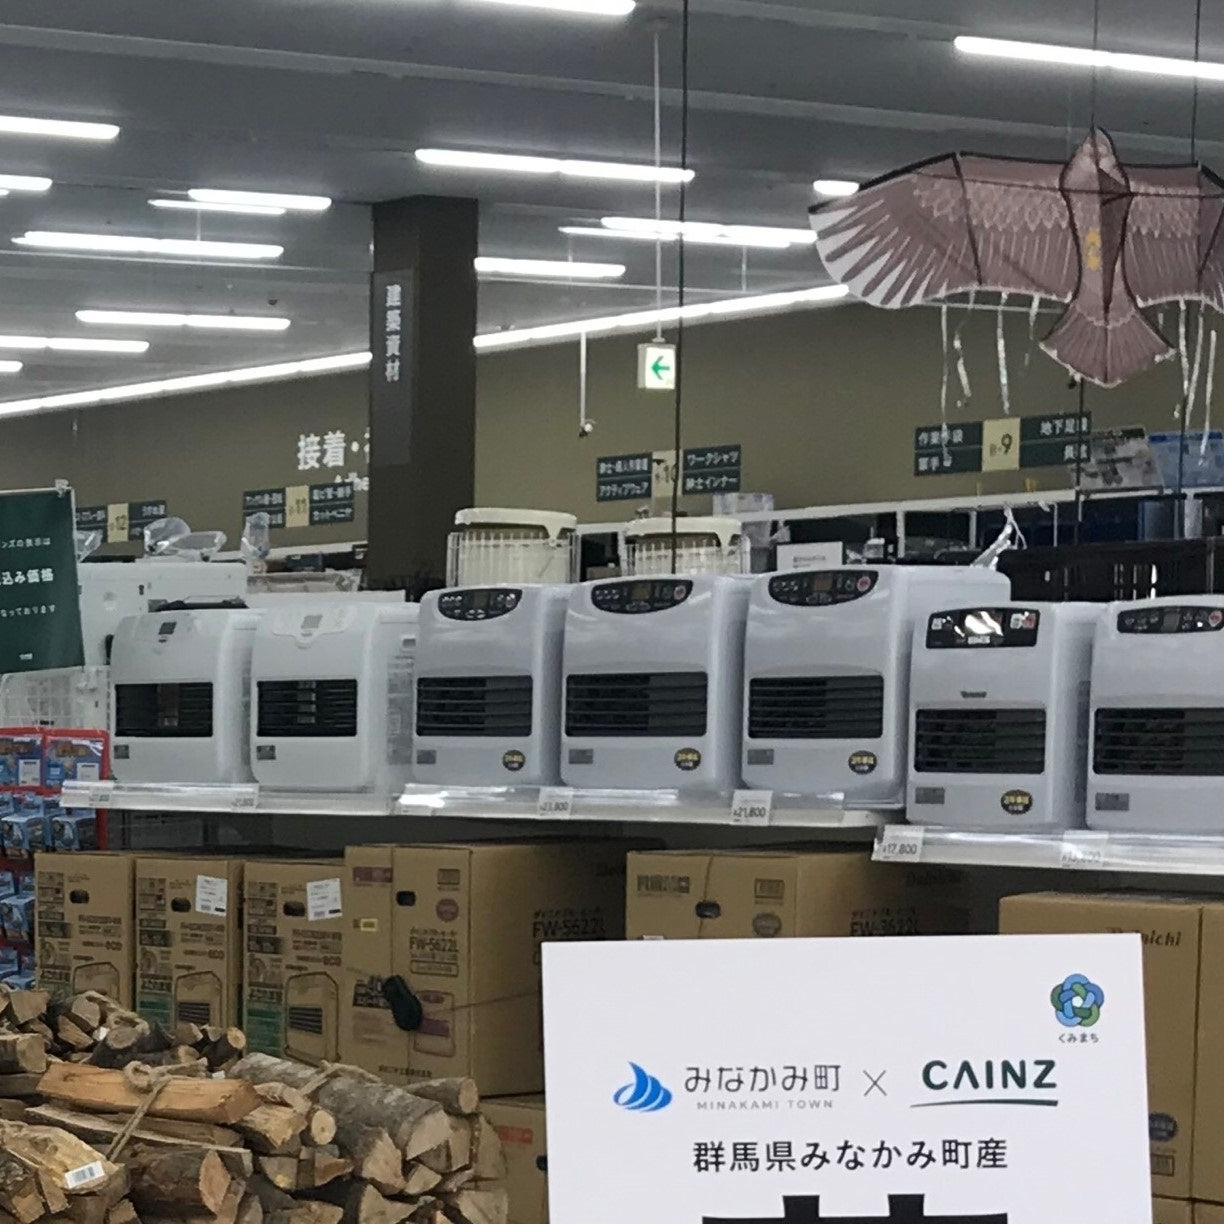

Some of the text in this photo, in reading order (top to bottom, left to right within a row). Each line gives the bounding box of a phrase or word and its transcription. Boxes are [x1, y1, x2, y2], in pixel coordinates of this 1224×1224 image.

[1057, 1033, 1101, 1045] くみまち
[684, 1063, 842, 1093] みなかみ町
[921, 1060, 1058, 1091] CAINZ
[697, 1100, 834, 1112] MINAKAMI TOWN
[692, 1138, 1009, 1173] 群馬県みなかみ町産
